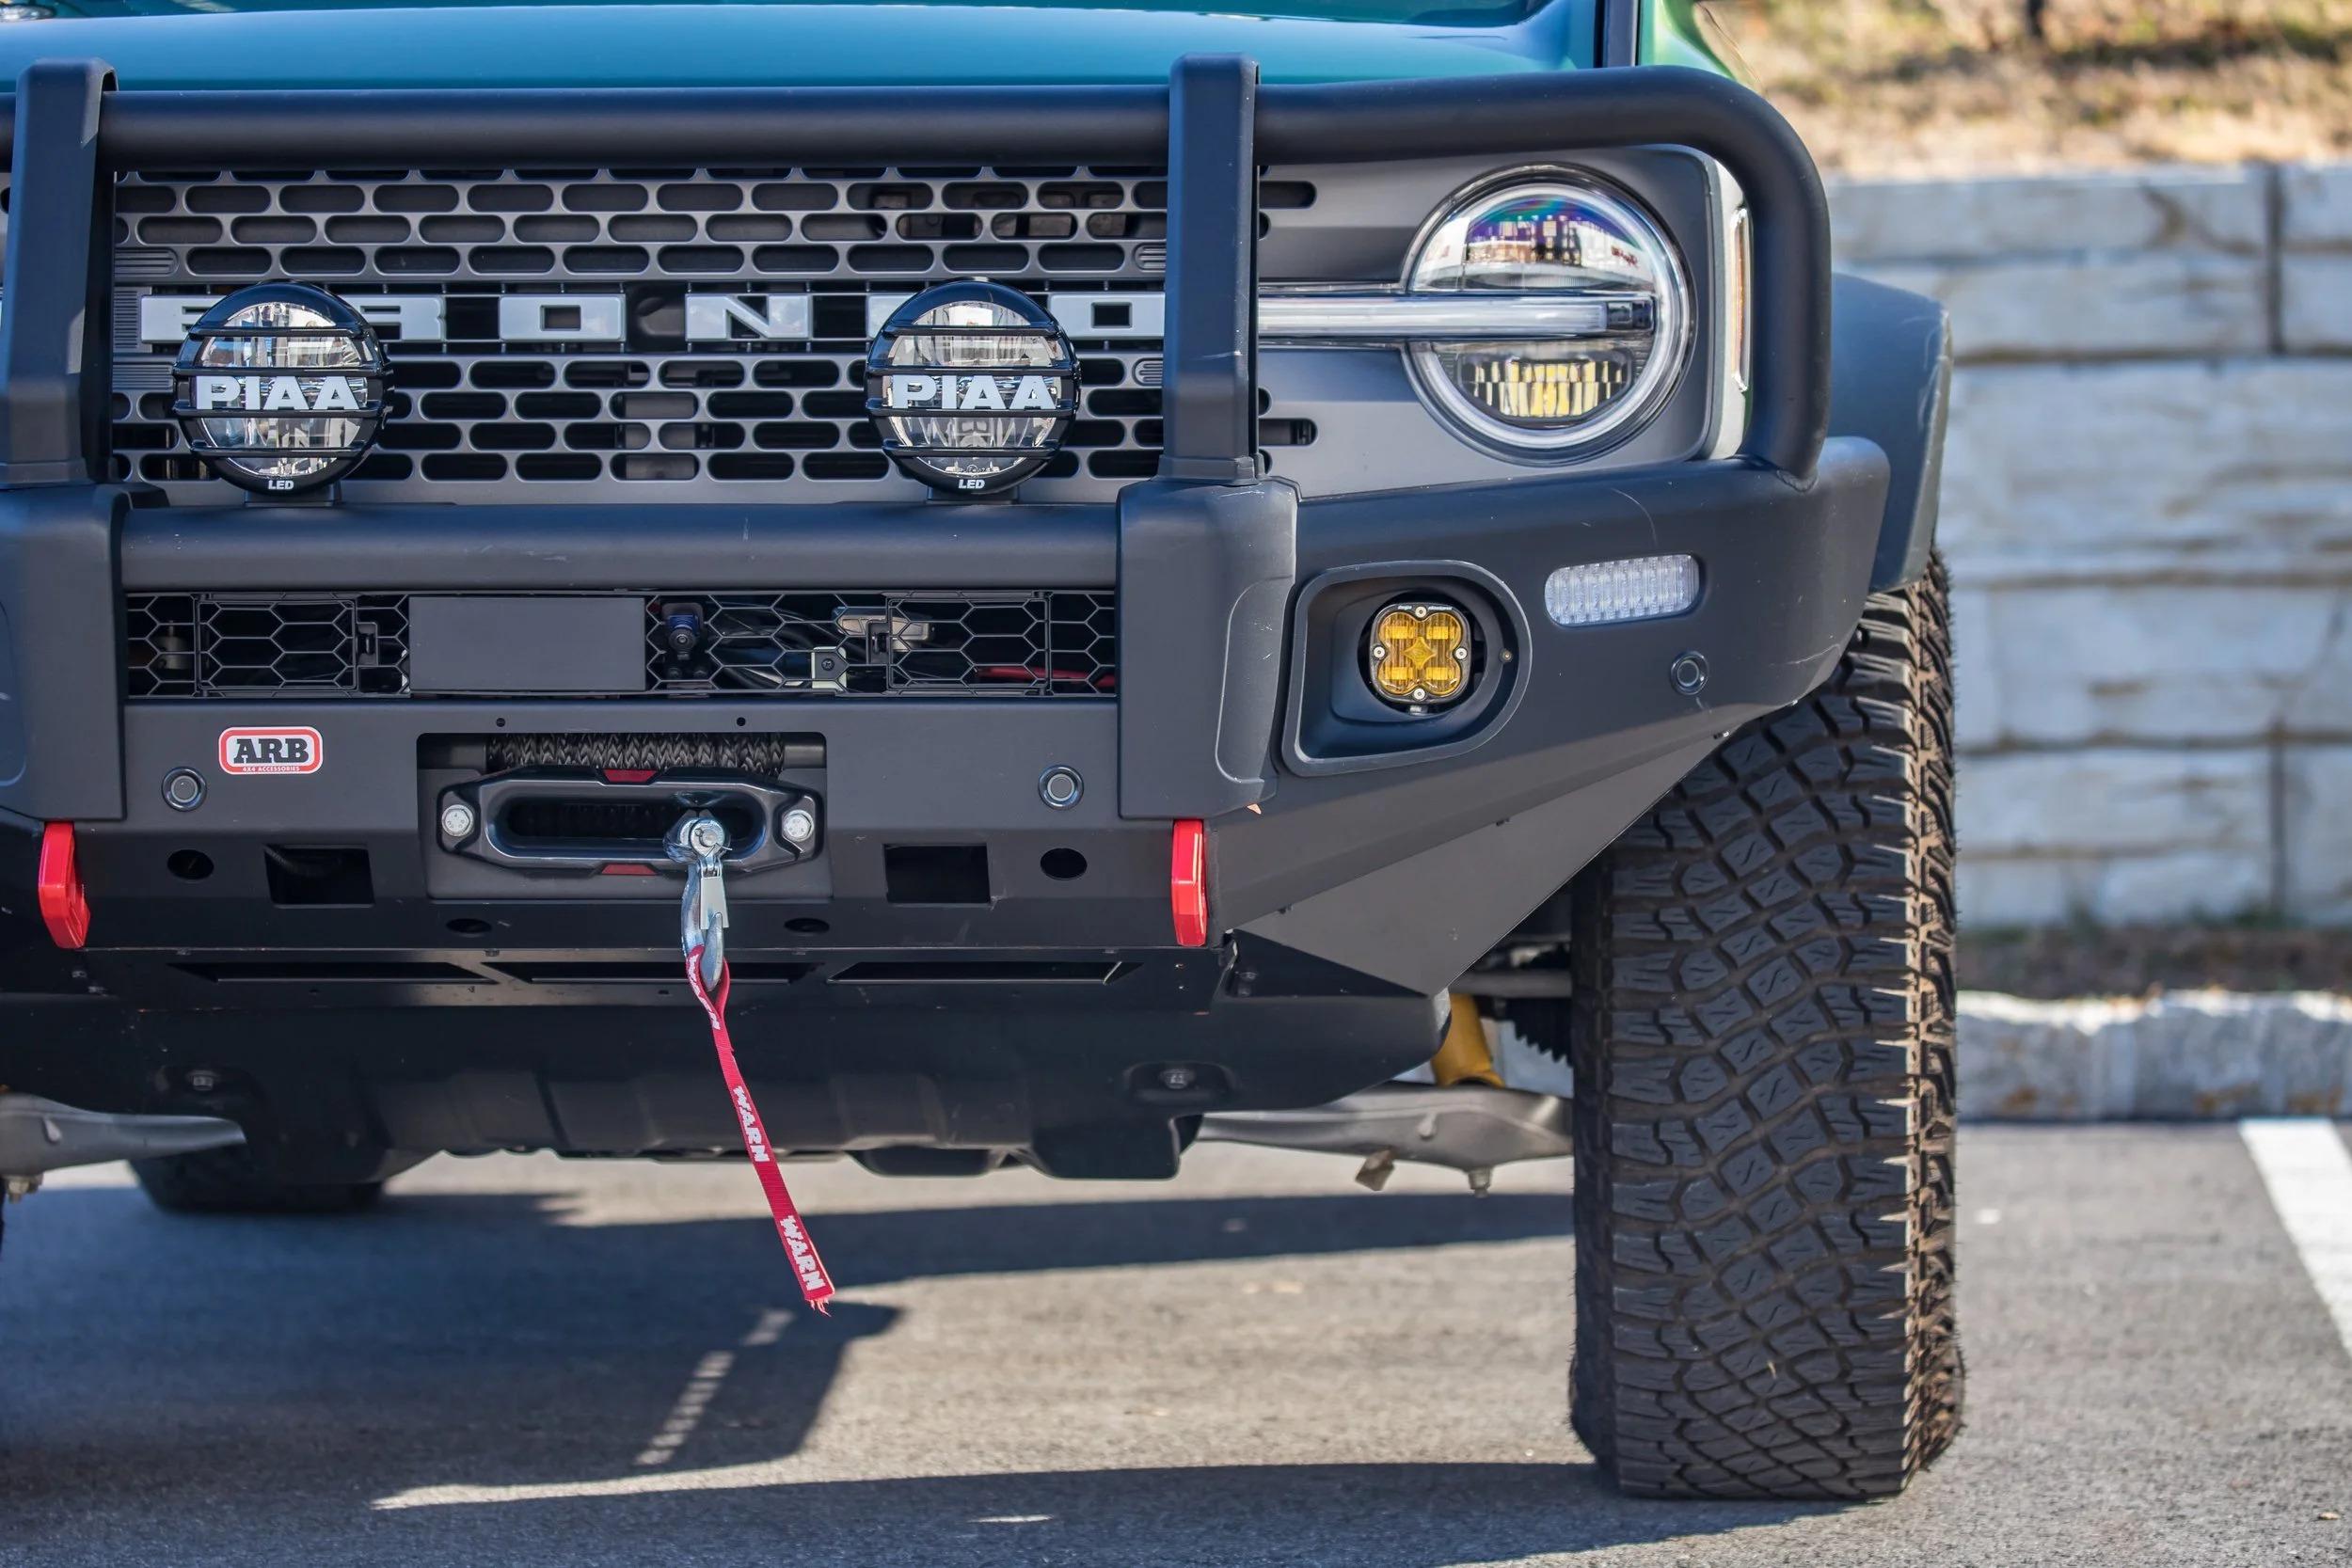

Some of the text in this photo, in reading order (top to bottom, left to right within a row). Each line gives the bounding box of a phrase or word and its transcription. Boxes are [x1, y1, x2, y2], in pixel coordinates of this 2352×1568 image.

[141, 293, 1166, 342] RONO
[196, 375, 360, 410] PIAA
[892, 375, 1057, 409] PIAA
[267, 480, 294, 490] LED
[958, 479, 986, 489] LED
[233, 737, 310, 764] ARB
[733, 1085, 771, 1163] WARN
[779, 1215, 826, 1291] WARN
